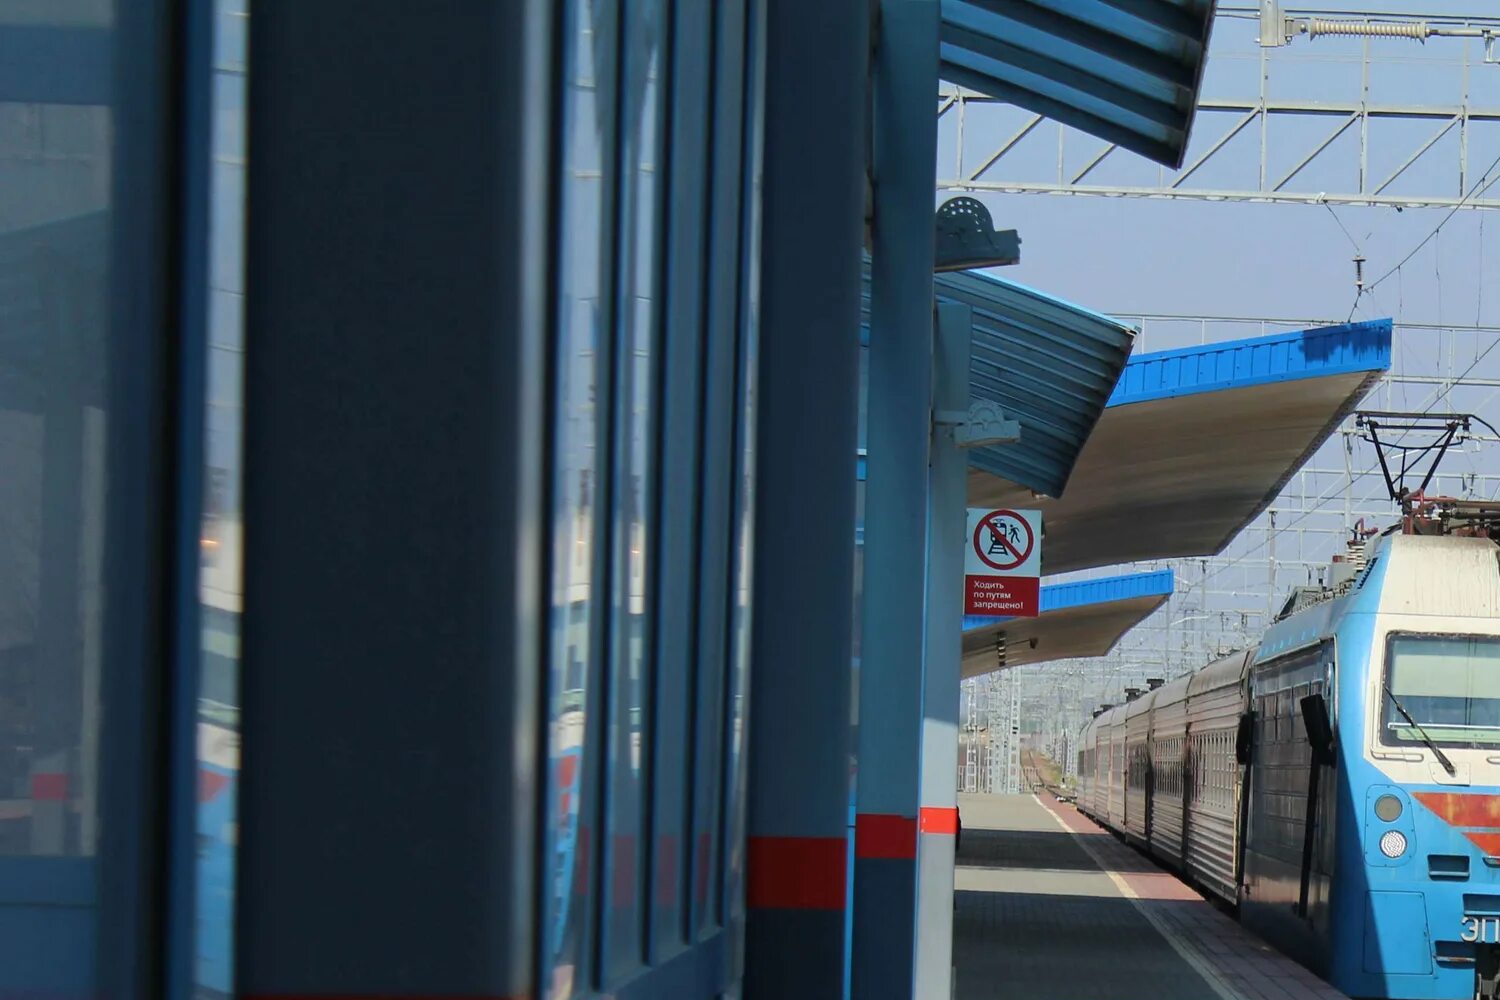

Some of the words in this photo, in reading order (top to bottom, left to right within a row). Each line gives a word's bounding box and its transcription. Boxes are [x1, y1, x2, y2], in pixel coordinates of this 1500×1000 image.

[973, 580, 1004, 589] Ходить
[986, 592, 1011, 600] путям
[973, 601, 1023, 609] запрещено!
